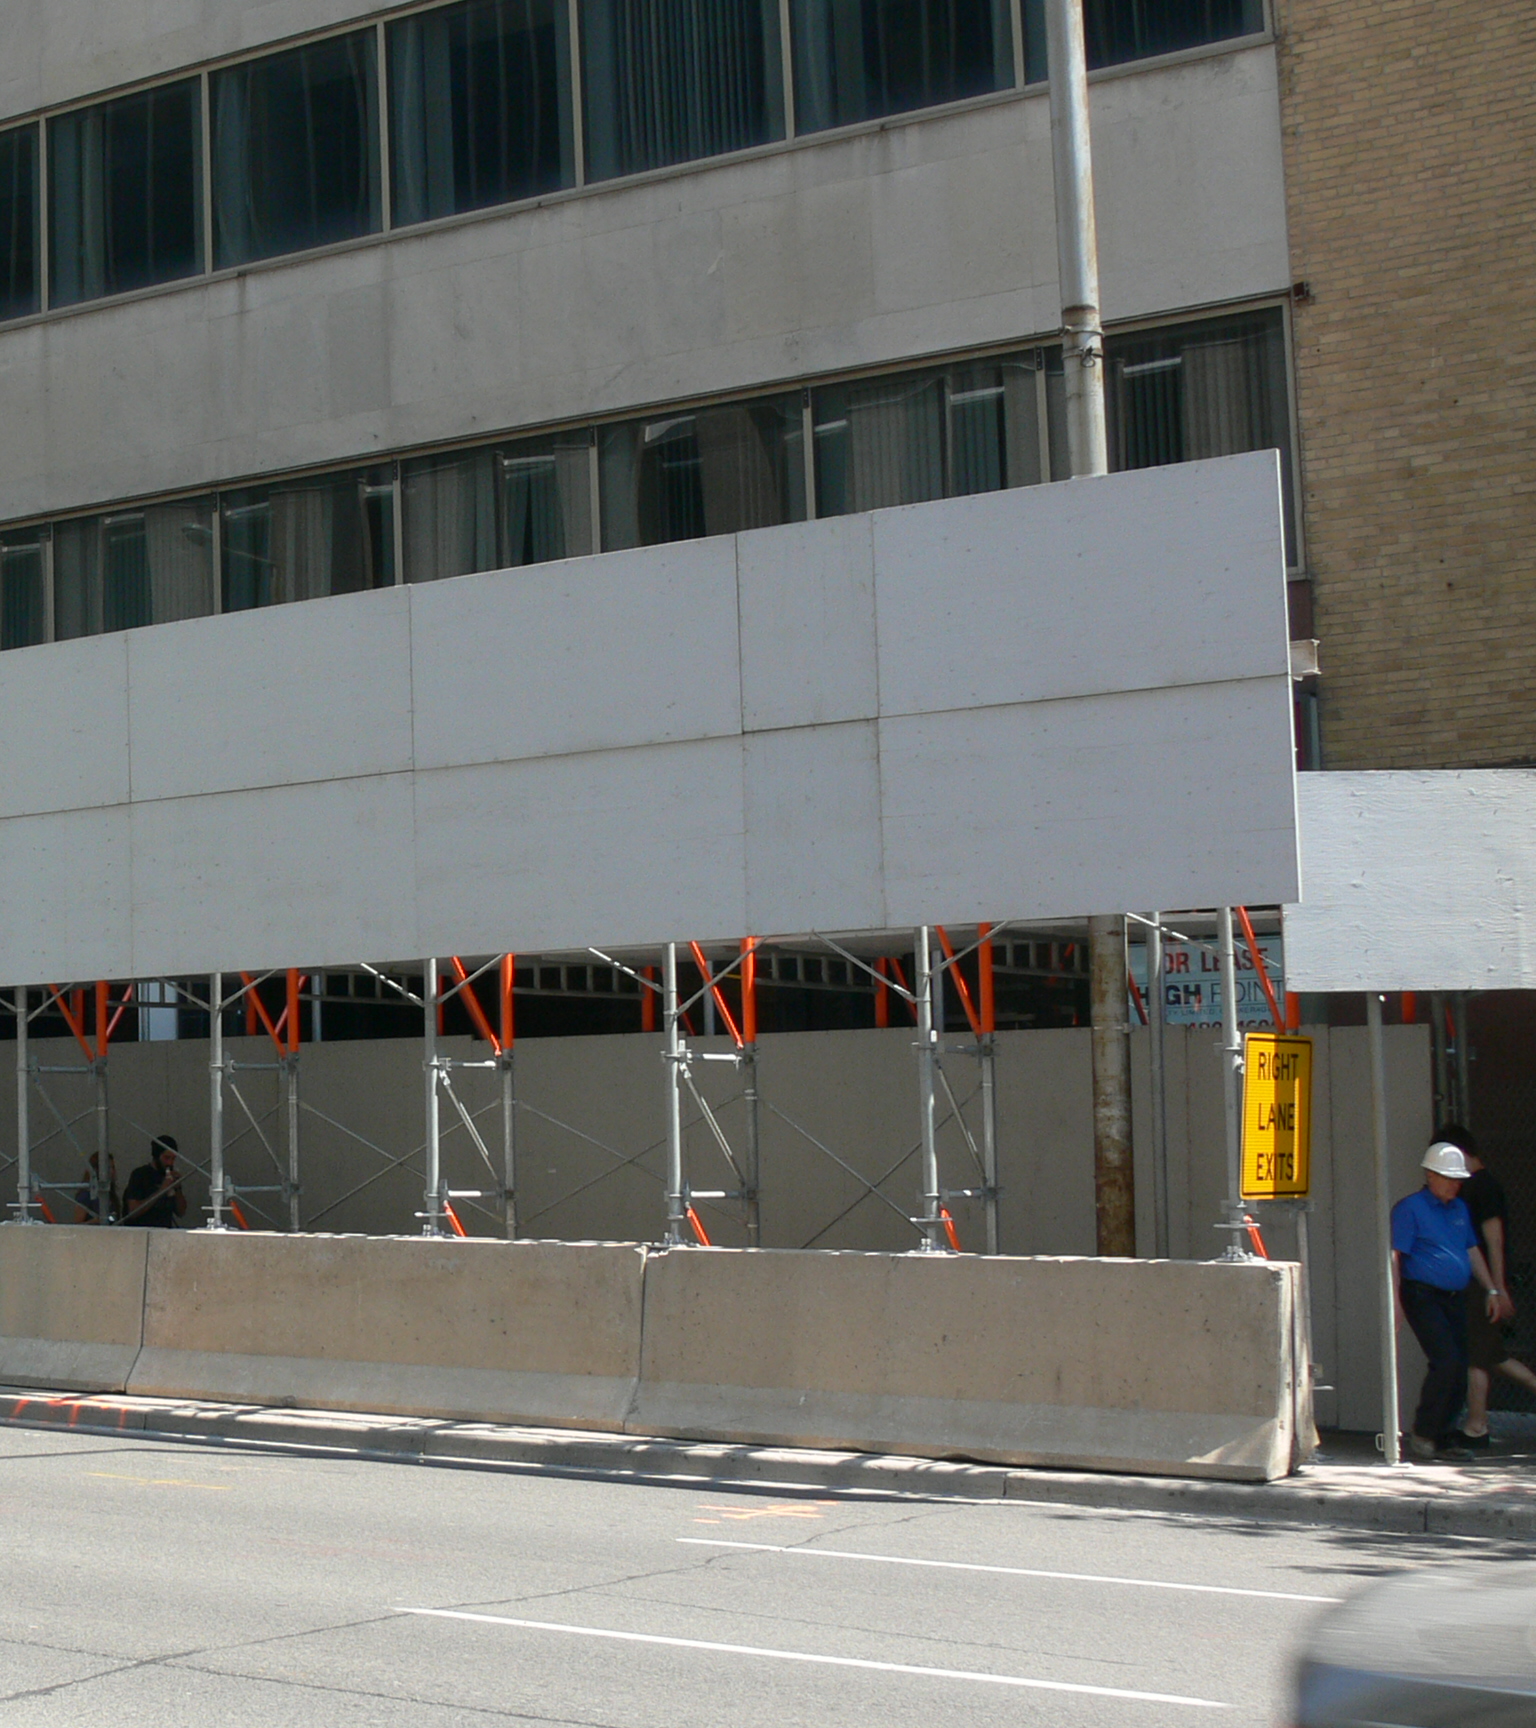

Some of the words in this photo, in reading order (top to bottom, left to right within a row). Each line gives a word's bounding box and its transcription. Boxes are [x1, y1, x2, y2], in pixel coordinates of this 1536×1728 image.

[1136, 984, 1201, 1006] HGH
[1258, 1052, 1299, 1081] RIGHT
[1258, 1102, 1296, 1131] LANE
[1256, 1152, 1294, 1182] EXITS
